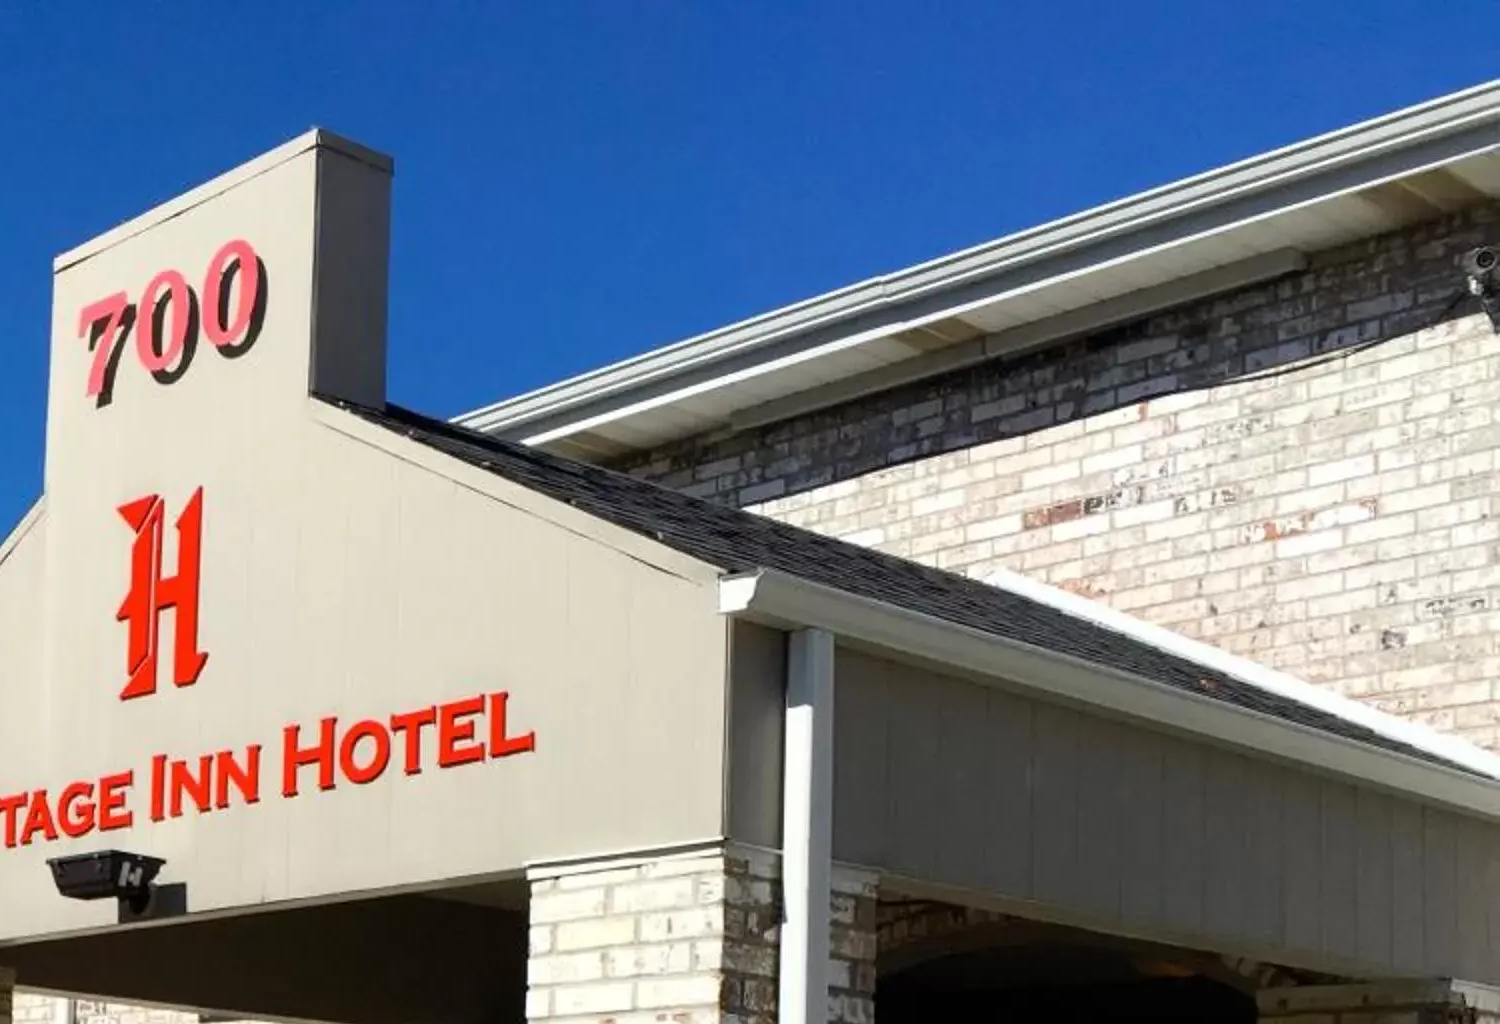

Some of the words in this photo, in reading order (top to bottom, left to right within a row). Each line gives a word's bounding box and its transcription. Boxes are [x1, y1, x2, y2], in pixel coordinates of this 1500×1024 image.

[78, 239, 268, 409] 700
[116, 486, 209, 702] H
[150, 743, 262, 822] INN
[281, 691, 536, 798] HOTEL
